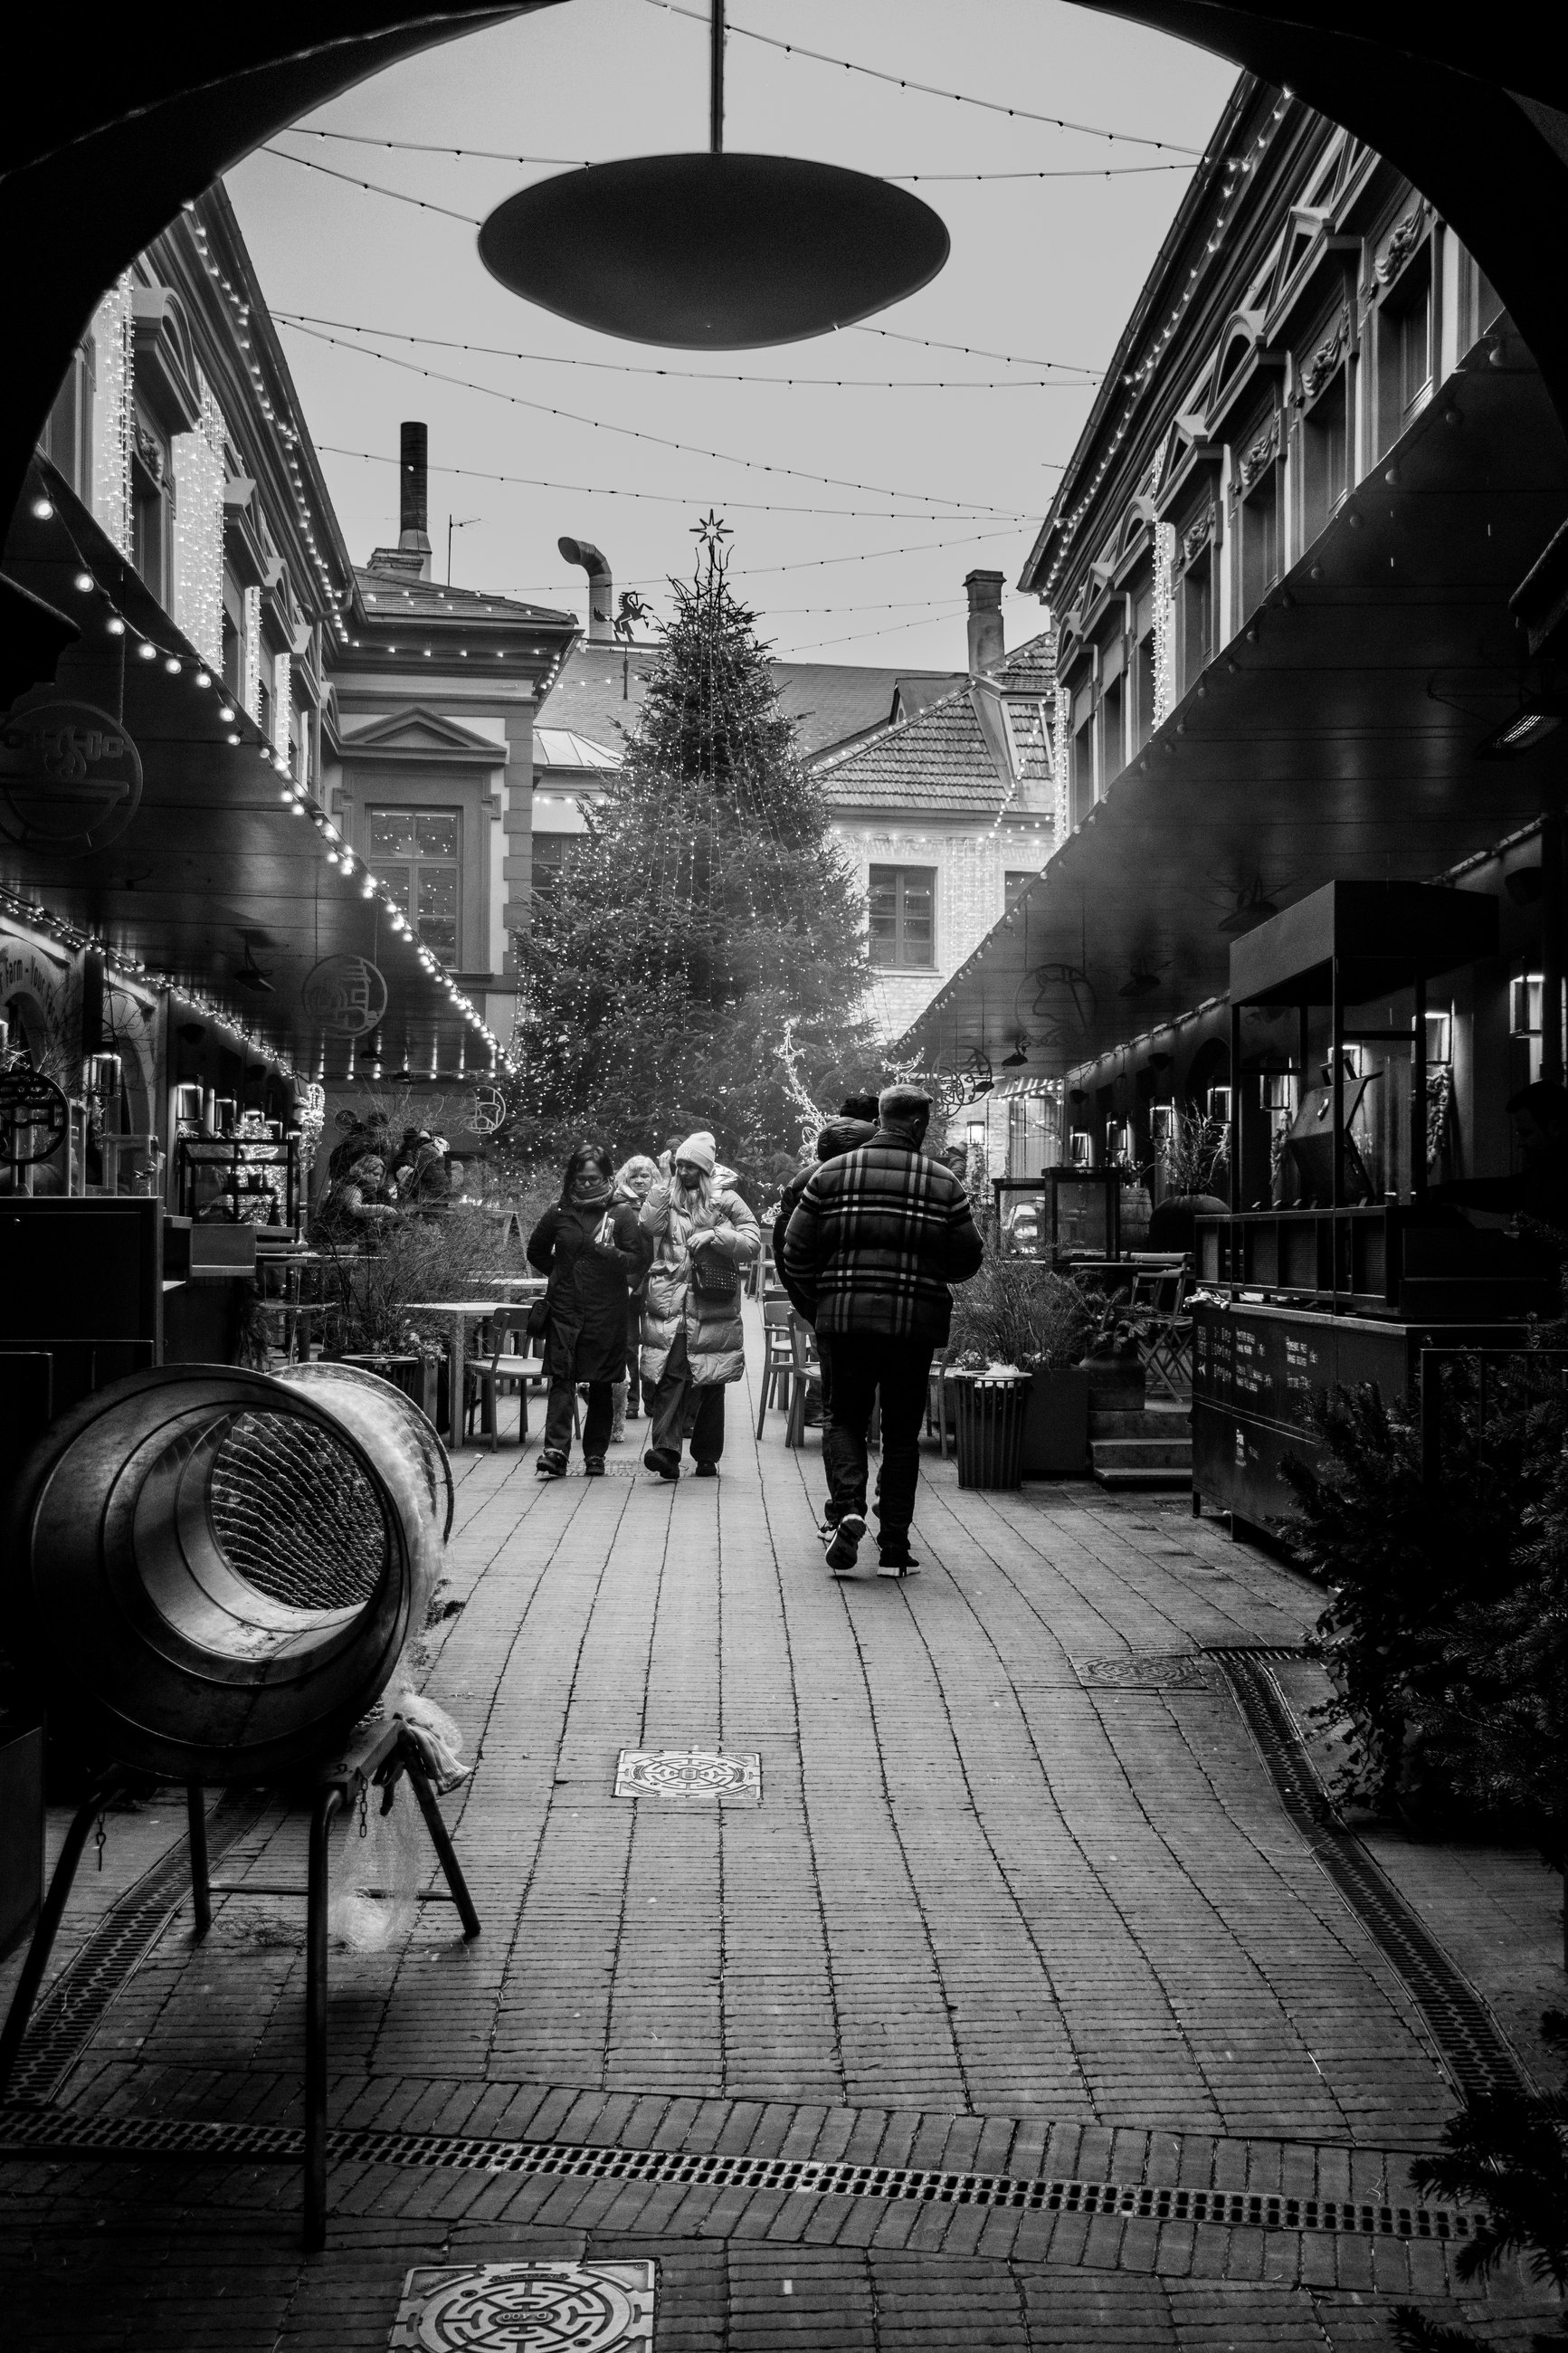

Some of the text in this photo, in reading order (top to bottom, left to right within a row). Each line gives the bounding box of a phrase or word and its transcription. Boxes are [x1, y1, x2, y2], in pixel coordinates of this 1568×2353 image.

[31, 955, 46, 997] Your
[502, 2310, 546, 2320] D 400
